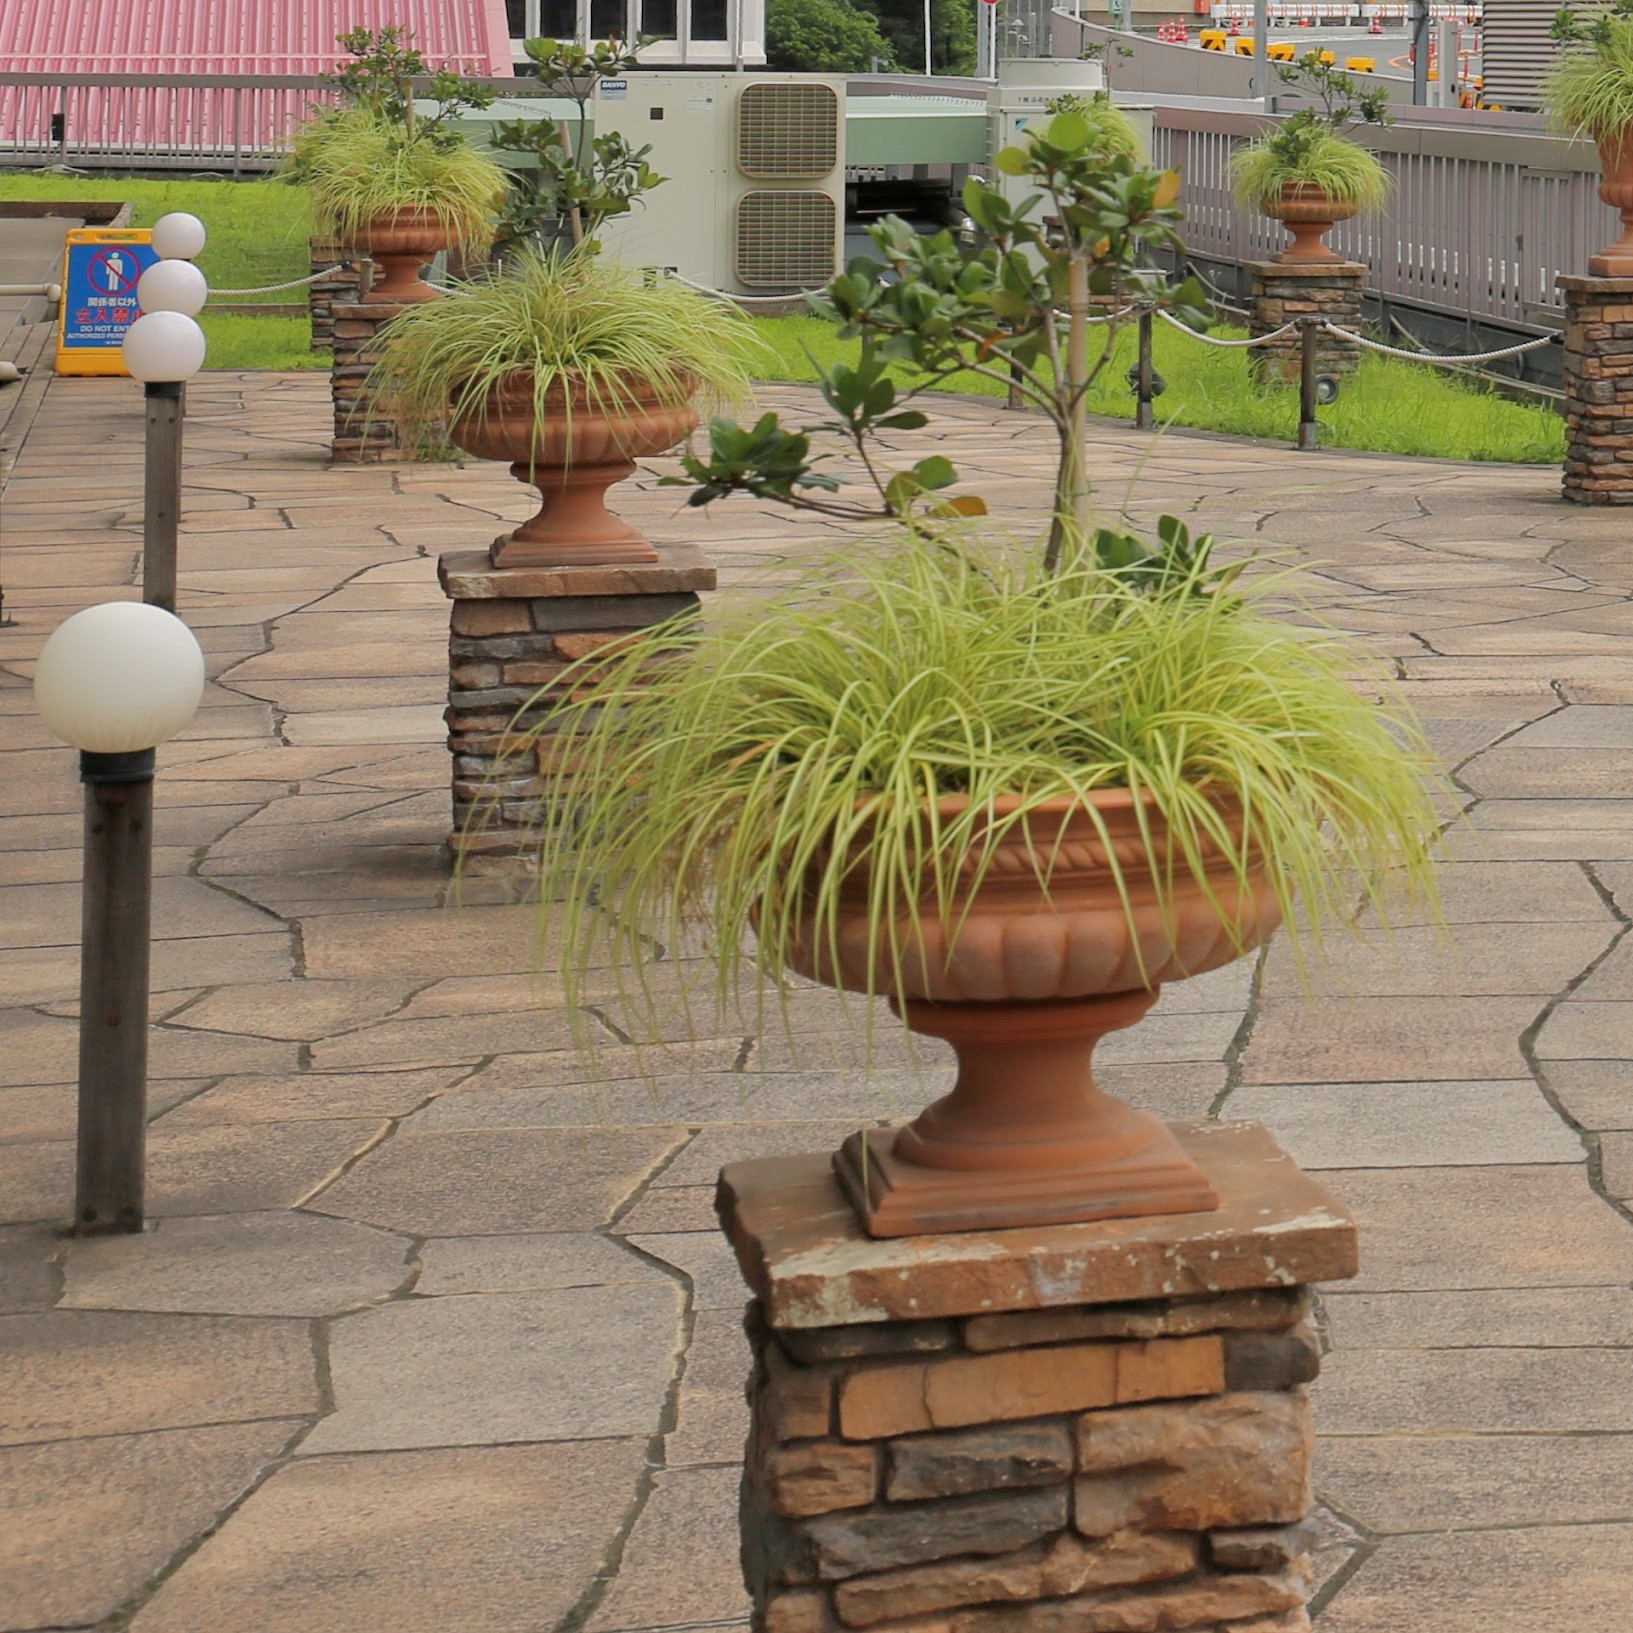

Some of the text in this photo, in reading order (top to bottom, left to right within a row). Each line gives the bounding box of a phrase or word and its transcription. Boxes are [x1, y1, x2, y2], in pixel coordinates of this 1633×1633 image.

[601, 81, 627, 89] SANYO
[80, 325, 131, 333] DO NOT ENT
